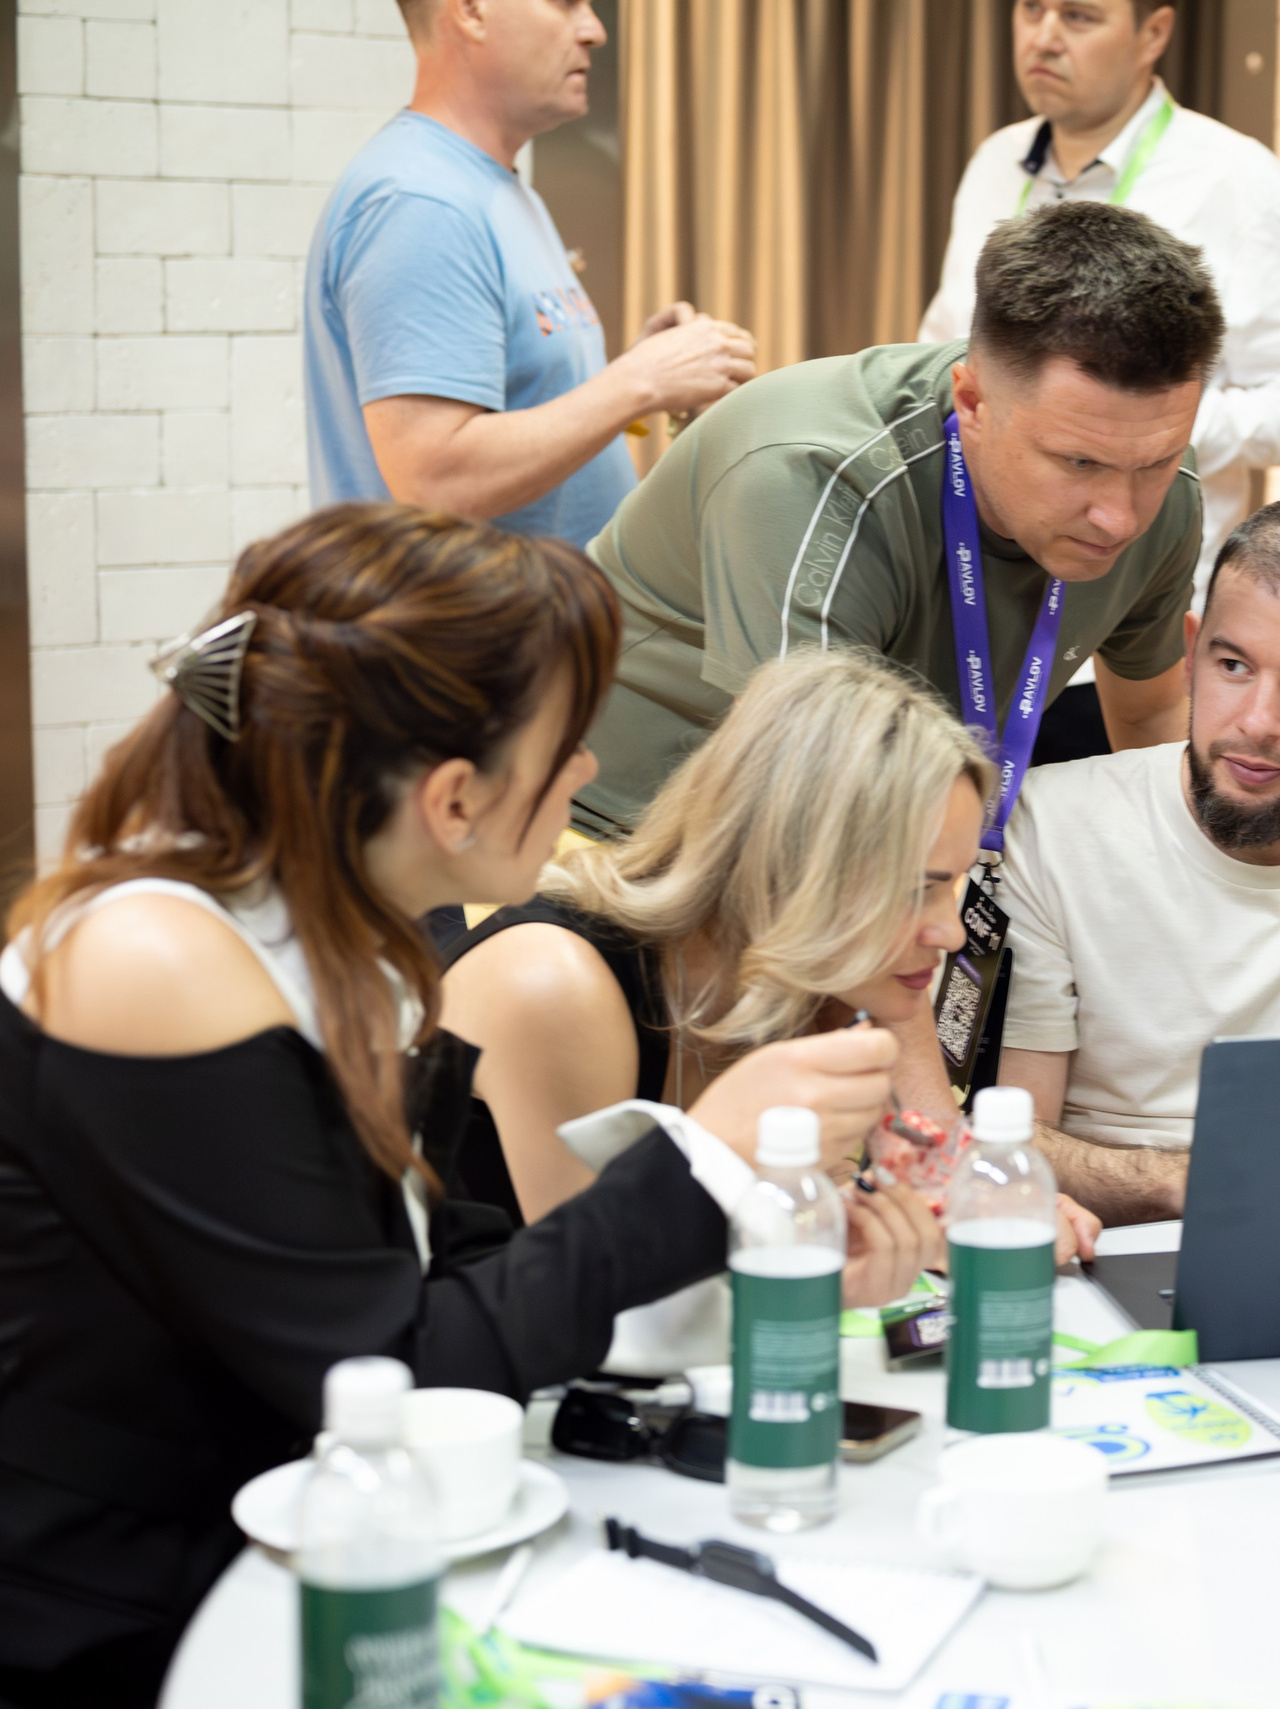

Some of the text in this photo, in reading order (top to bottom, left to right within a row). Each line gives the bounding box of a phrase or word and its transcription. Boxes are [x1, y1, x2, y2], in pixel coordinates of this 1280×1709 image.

[948, 432, 966, 497] PAVLOV
[793, 532, 846, 607] Calvin
[956, 542, 976, 606] PAVLOV
[1048, 578, 1062, 616] PAV
[966, 650, 987, 713] PAVLOV
[1019, 656, 1043, 719] PAVLOV
[1000, 760, 1016, 797] VLOV
